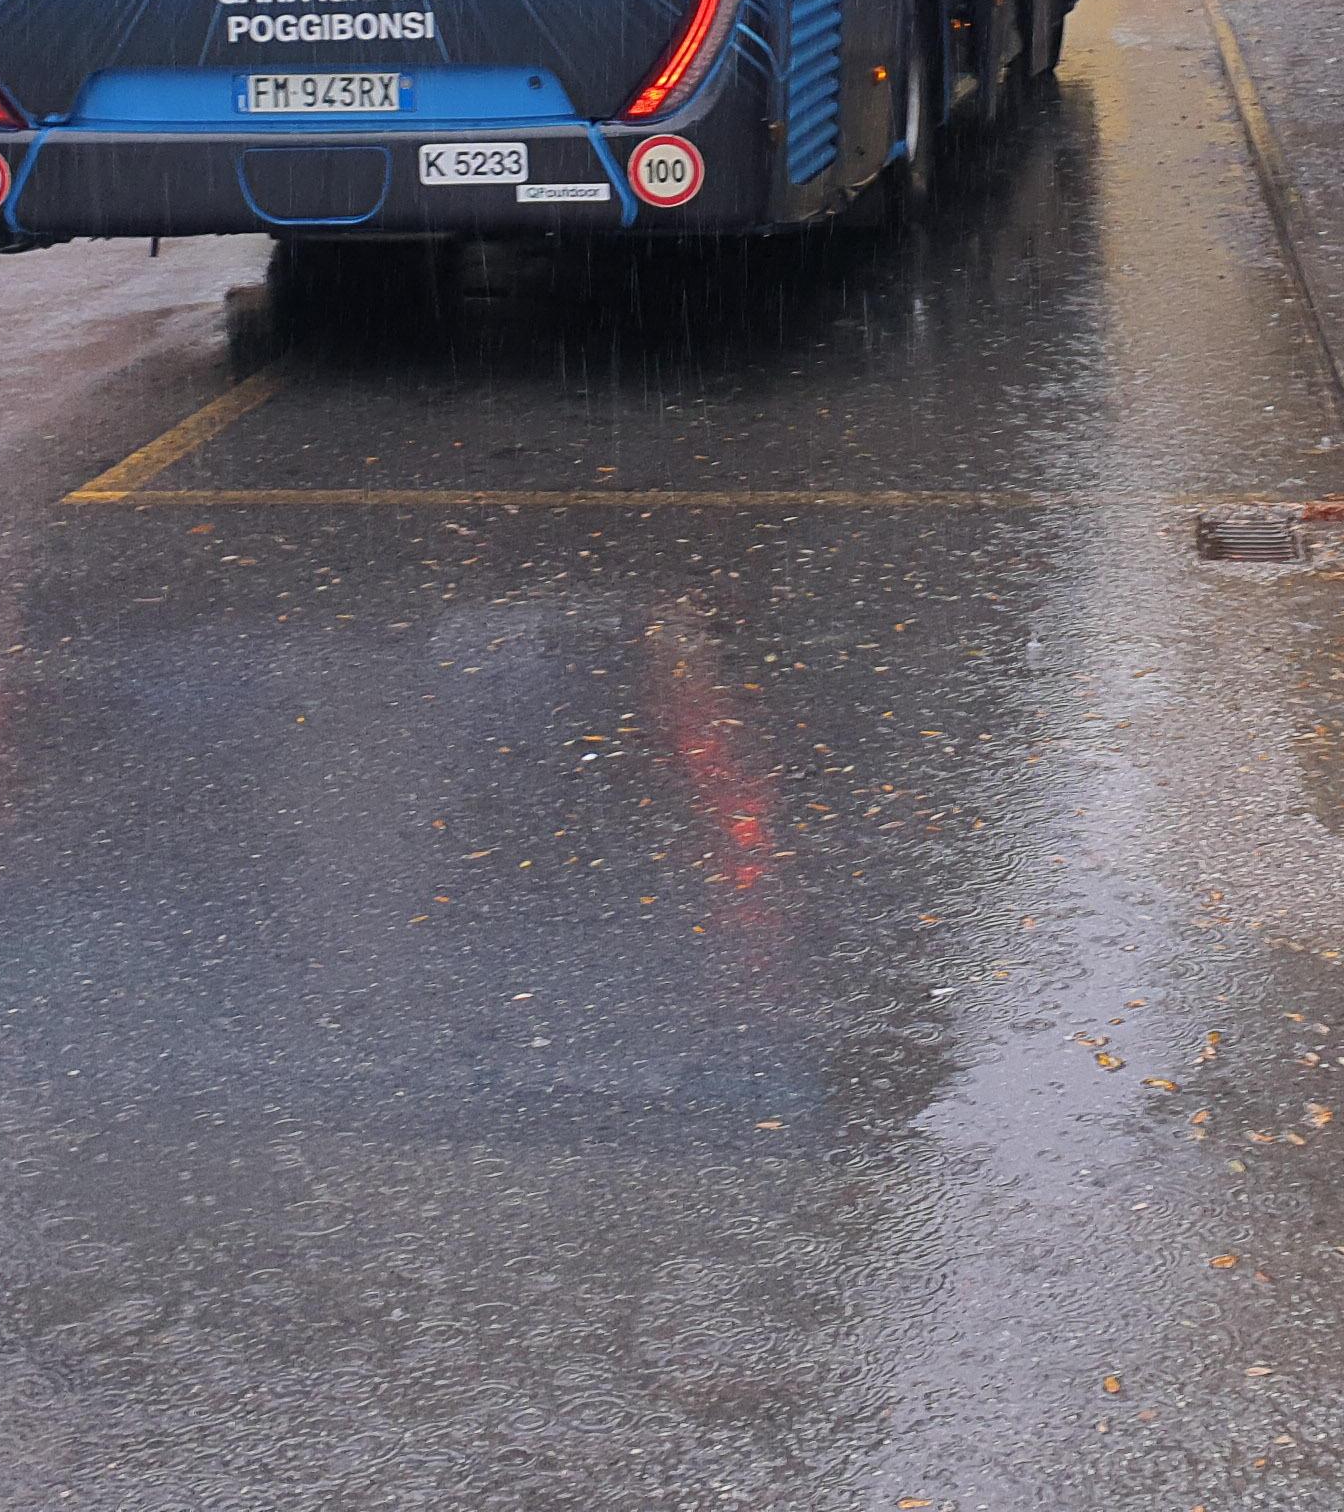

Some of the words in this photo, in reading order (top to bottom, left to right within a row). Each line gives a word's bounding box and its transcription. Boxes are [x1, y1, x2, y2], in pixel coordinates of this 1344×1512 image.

[227, 11, 435, 43] POGGIBONSI
[424, 151, 447, 178] K
[453, 149, 523, 177] 5233
[644, 158, 687, 184] 100
